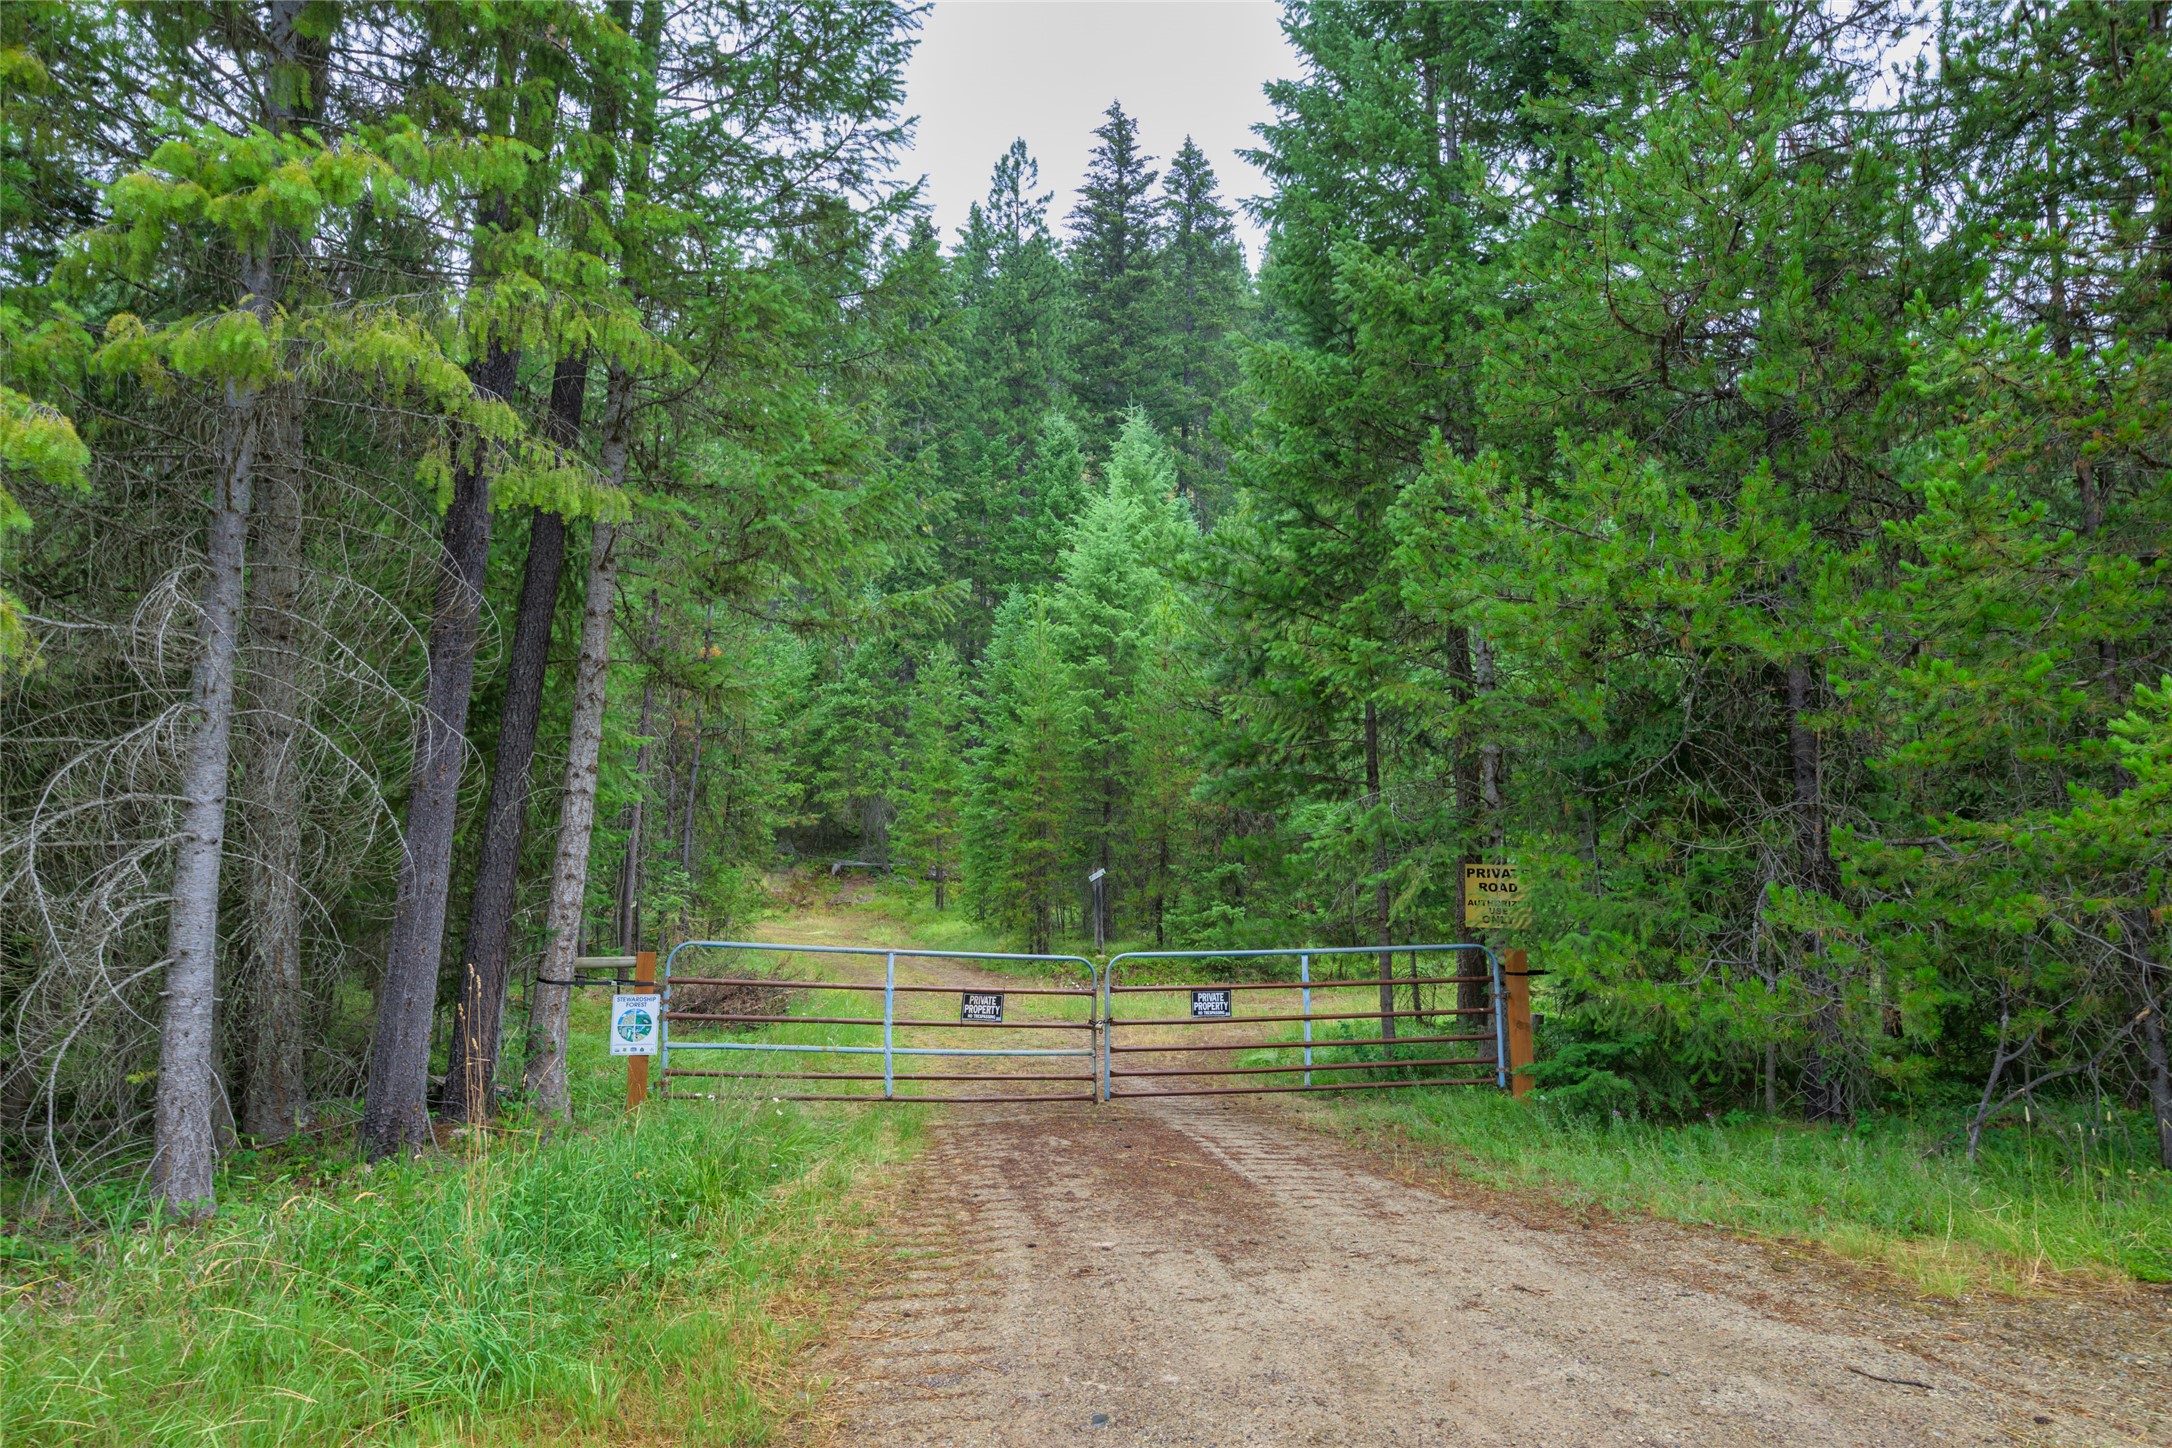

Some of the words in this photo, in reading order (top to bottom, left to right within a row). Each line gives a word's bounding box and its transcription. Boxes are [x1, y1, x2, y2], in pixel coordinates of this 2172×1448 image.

[1466, 868, 1530, 878] PRIVAT
[1479, 882, 1518, 893] ROAD
[1467, 899, 1523, 907] AUTHORIZ
[1488, 907, 1508, 915] USE
[969, 996, 997, 1005] PRIVATE
[1197, 993, 1224, 1001] PRIVATE
[964, 1005, 1000, 1014] PROPERTY
[1193, 1002, 1228, 1011] PROPERTY
